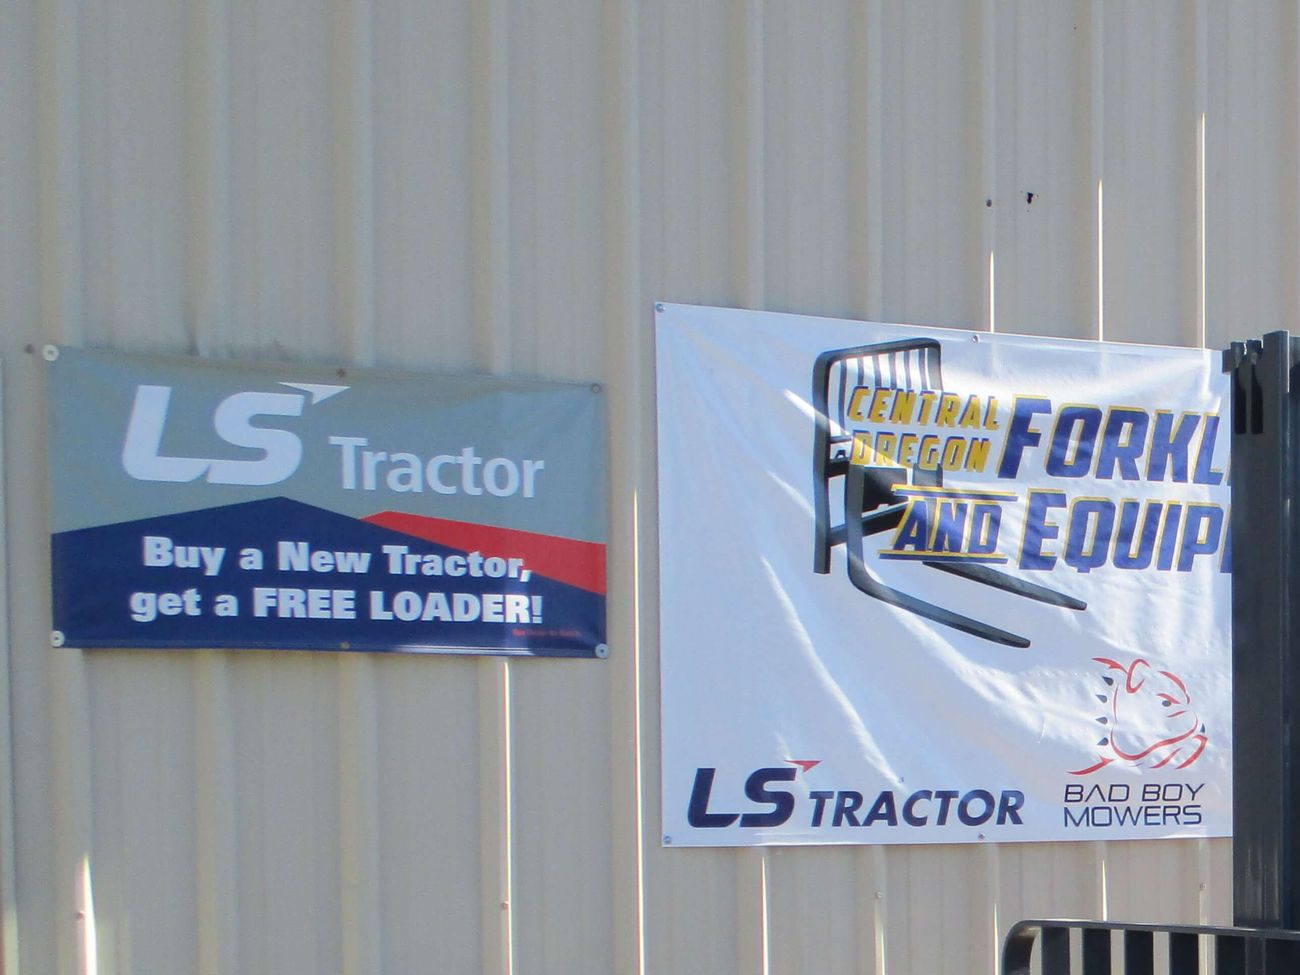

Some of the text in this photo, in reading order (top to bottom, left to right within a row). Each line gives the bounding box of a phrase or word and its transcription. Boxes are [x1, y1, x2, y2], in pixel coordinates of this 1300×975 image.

[847, 385, 1000, 431] CENTRAL
[122, 384, 545, 498] LS Tractor
[850, 429, 992, 473] OREGON
[996, 393, 1231, 486] FORKL
[891, 494, 1004, 557] AND
[142, 535, 532, 584] Buy a New Tractor,
[130, 587, 544, 624] get a FREE LOADER!
[686, 767, 1025, 829] LS TRACTOR
[1063, 783, 1206, 803] BAD BOY
[1063, 804, 1203, 828] MOWERS
